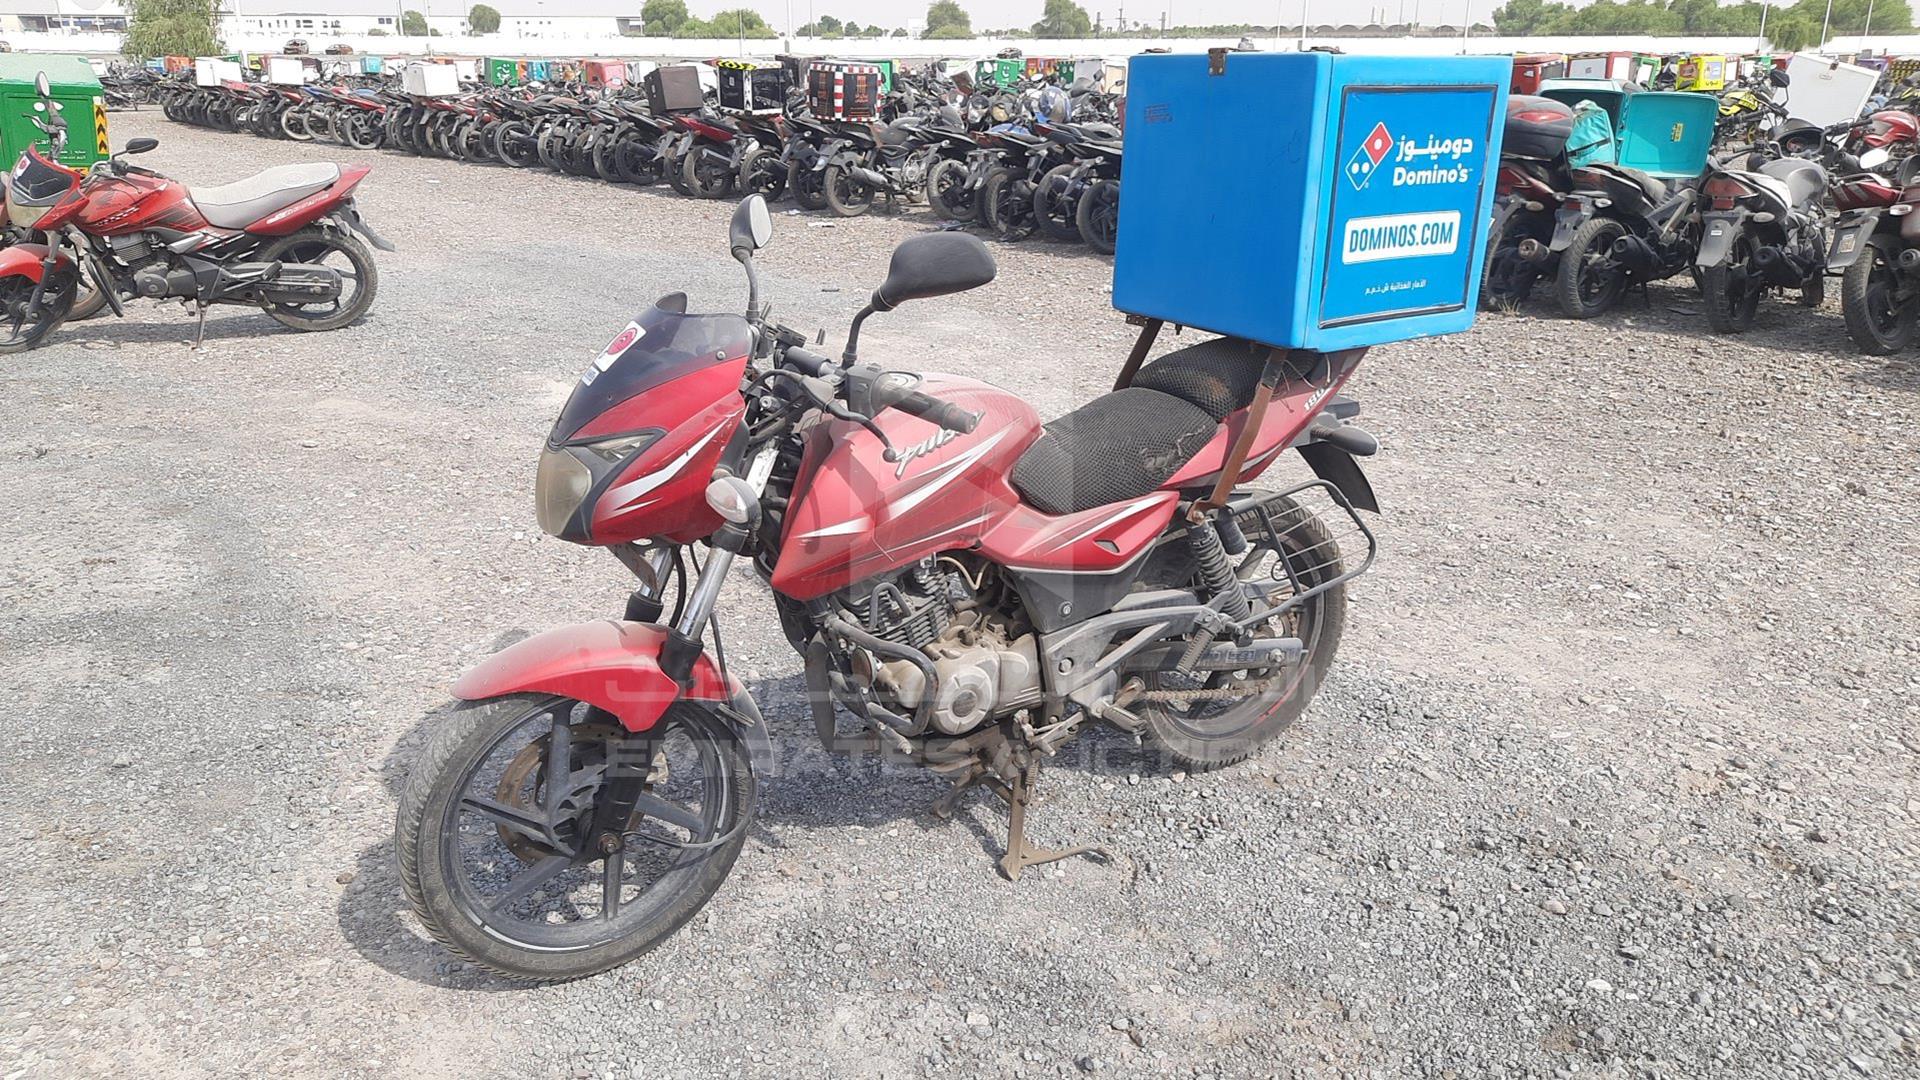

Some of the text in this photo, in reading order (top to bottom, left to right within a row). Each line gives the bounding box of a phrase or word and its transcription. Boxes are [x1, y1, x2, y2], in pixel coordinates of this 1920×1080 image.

[1395, 134, 1473, 162] دومينوز
[1392, 163, 1469, 186] Domino's
[1349, 221, 1454, 253] DOMINOS.COM
